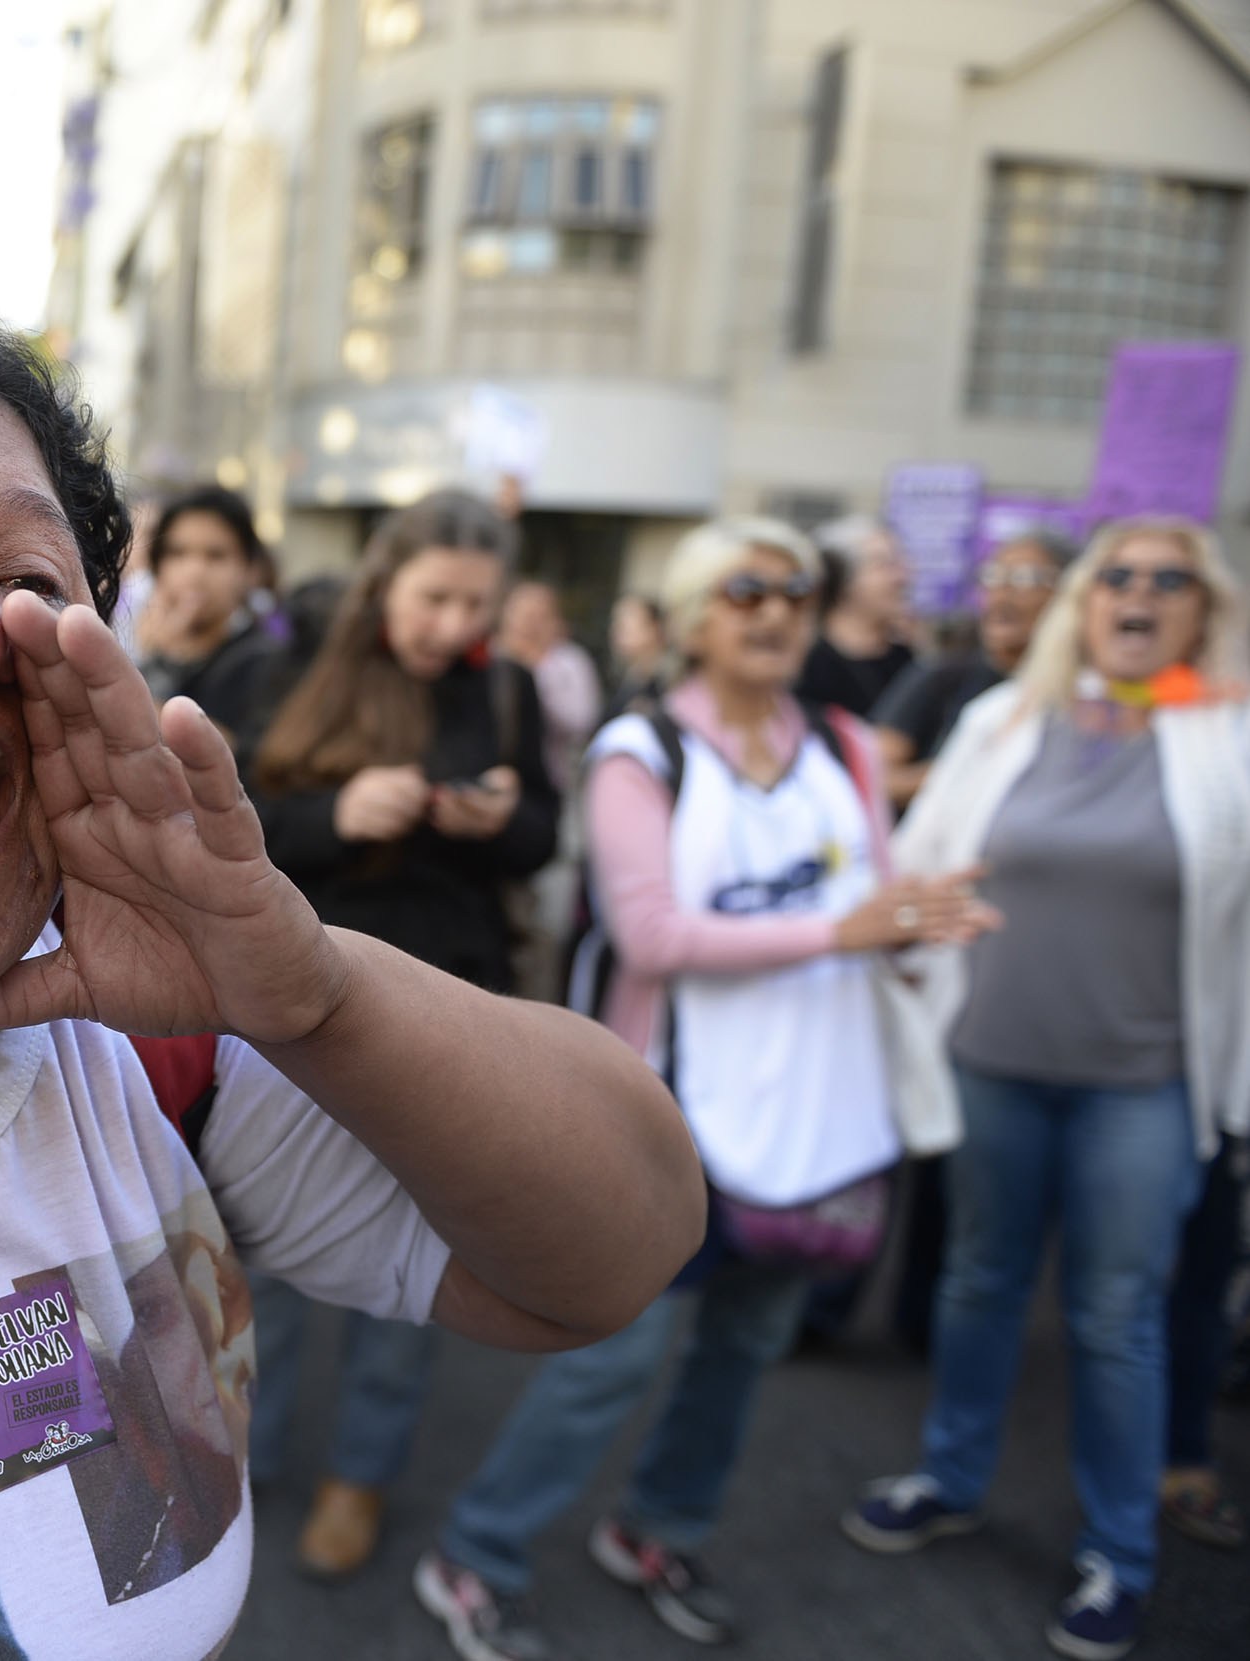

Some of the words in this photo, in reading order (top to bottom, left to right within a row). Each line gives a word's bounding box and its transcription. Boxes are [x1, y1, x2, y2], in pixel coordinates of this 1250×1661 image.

[12, 1394, 25, 1408] EL
[26, 1383, 64, 1404] ESTADO
[65, 1379, 79, 1394] ES
[13, 1393, 83, 1422] RESPONSABLE
